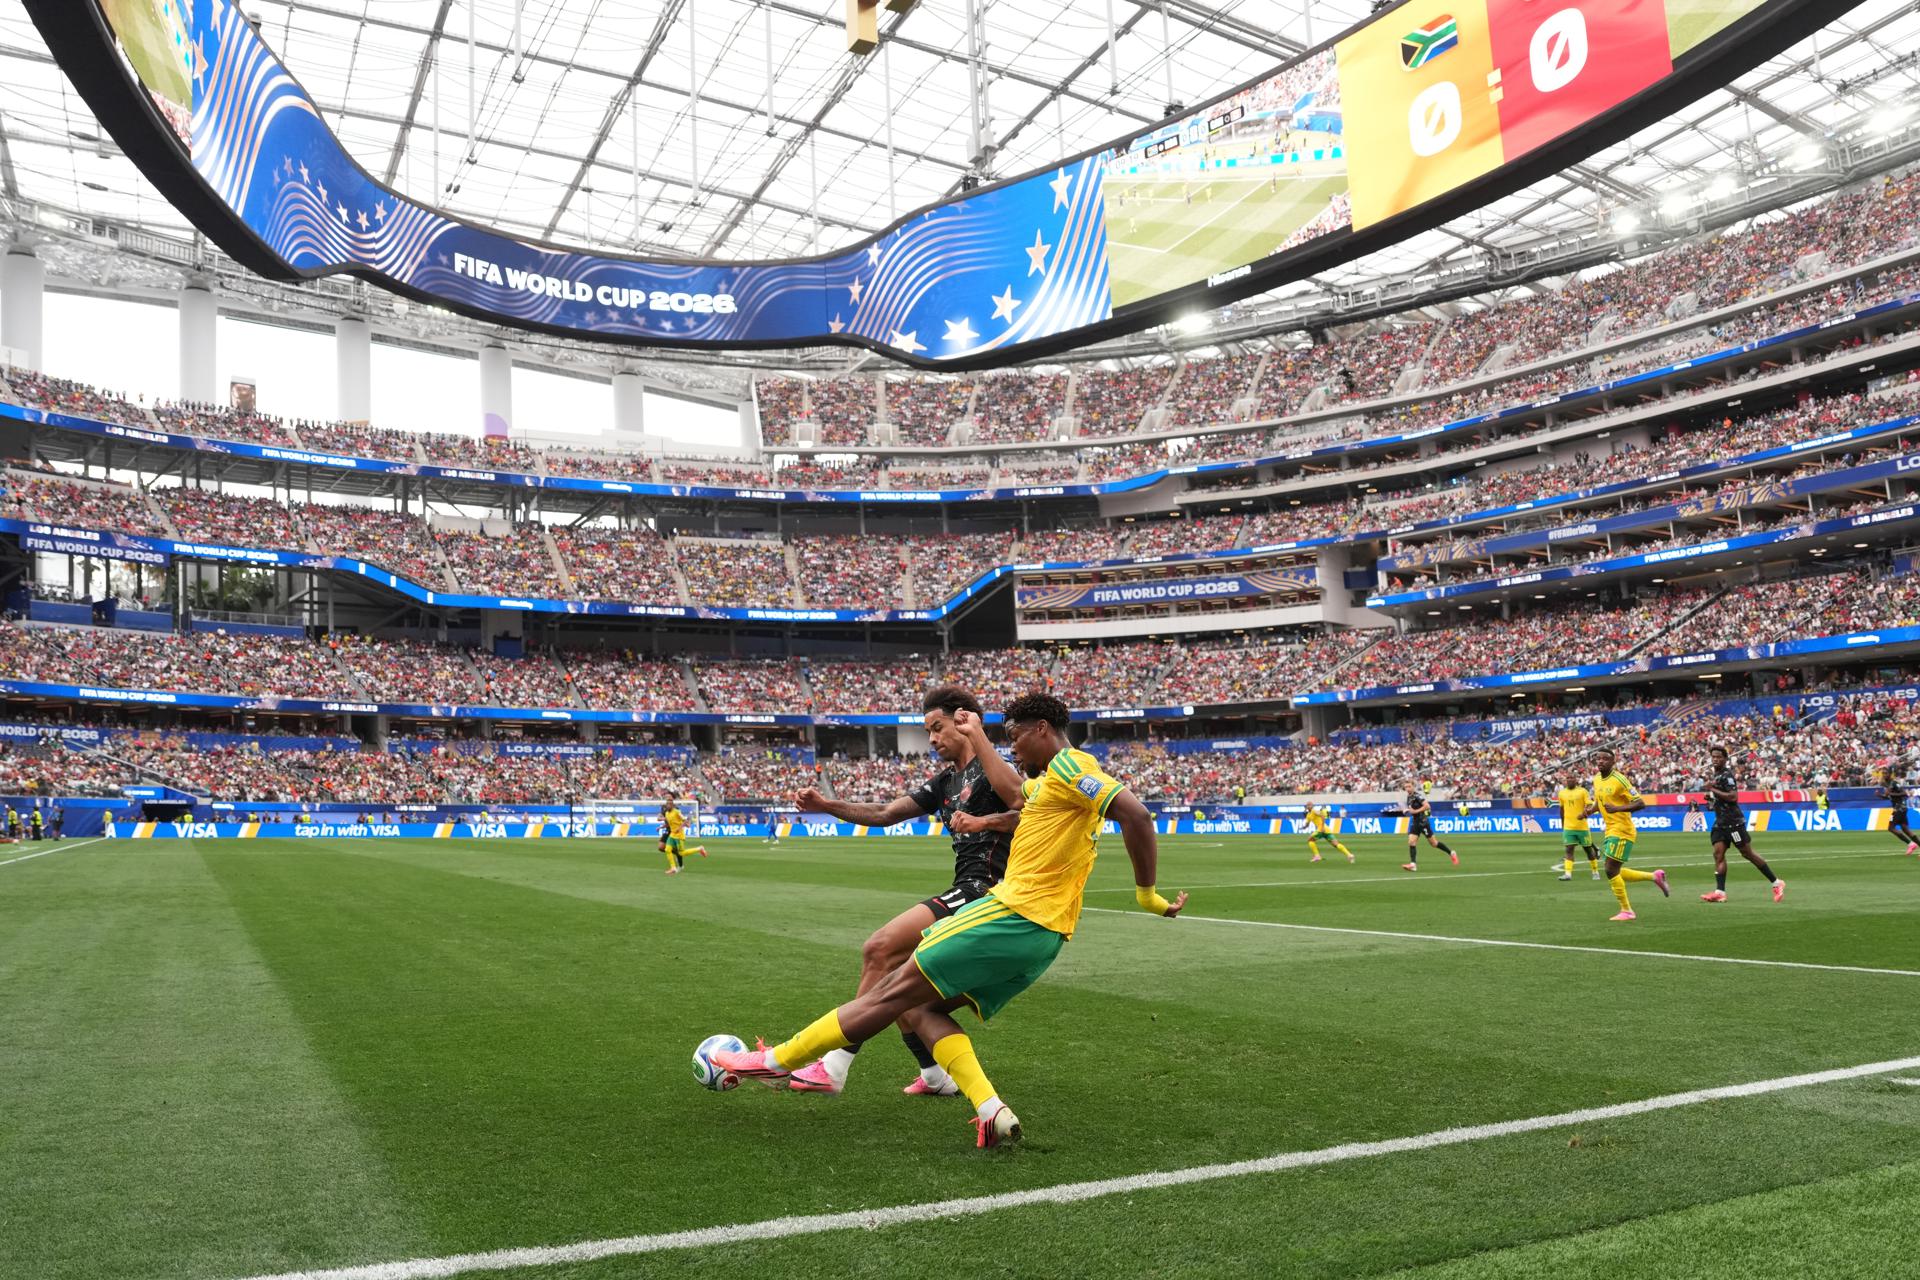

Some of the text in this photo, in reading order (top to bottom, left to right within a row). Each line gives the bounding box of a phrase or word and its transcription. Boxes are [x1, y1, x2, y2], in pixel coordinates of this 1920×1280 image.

[1528, 7, 1588, 93] 0
[1407, 80, 1462, 157] 0
[454, 252, 735, 314] FIFA WORLD CUP 2026
[105, 425, 169, 444] LOS ANGELES
[262, 448, 282, 457] FIFA
[281, 451, 311, 462] WORLD
[311, 455, 327, 464] CUP
[441, 469, 495, 481] LOS ANGELES
[1852, 507, 1914, 526] LOS ANGELES
[29, 525, 101, 542] LOS ANGELES
[27, 538, 165, 564] FIFA WORLD CUP 2026
[174, 544, 193, 554] FIFA
[193, 546, 228, 557] WORLD
[227, 549, 247, 558] CUP
[1644, 553, 1661, 563] FIFA
[1659, 549, 1687, 561] WORLD
[1686, 546, 1702, 556] CUP
[1094, 581, 1240, 602] FIFA WORLD CUP 2026
[647, 607, 685, 615] ANGELES
[748, 611, 765, 619] FIFA
[765, 611, 794, 619] WORLD
[794, 611, 809, 619] CUP
[1667, 653, 1716, 666] LOS ANGELES
[80, 689, 98, 697] FIFA
[97, 690, 128, 700] WORLD
[128, 692, 146, 700] CUP
[322, 703, 378, 713] LOS ANGELES
[1492, 720, 1513, 732] FIFA
[506, 745, 532, 753] LOS
[1193, 820, 1251, 833] tap in with VISA
[1350, 818, 1381, 834] VISA
[1434, 817, 1520, 833] tap in with VISA
[1786, 809, 1842, 831] VISA
[171, 822, 218, 838] VISA
[295, 824, 401, 838] tap in with VISA
[466, 823, 507, 838] VISA
[719, 825, 747, 836] VISA
[804, 823, 839, 836] VISA
[1730, 831, 1741, 843] 10
[940, 888, 966, 909] 11
